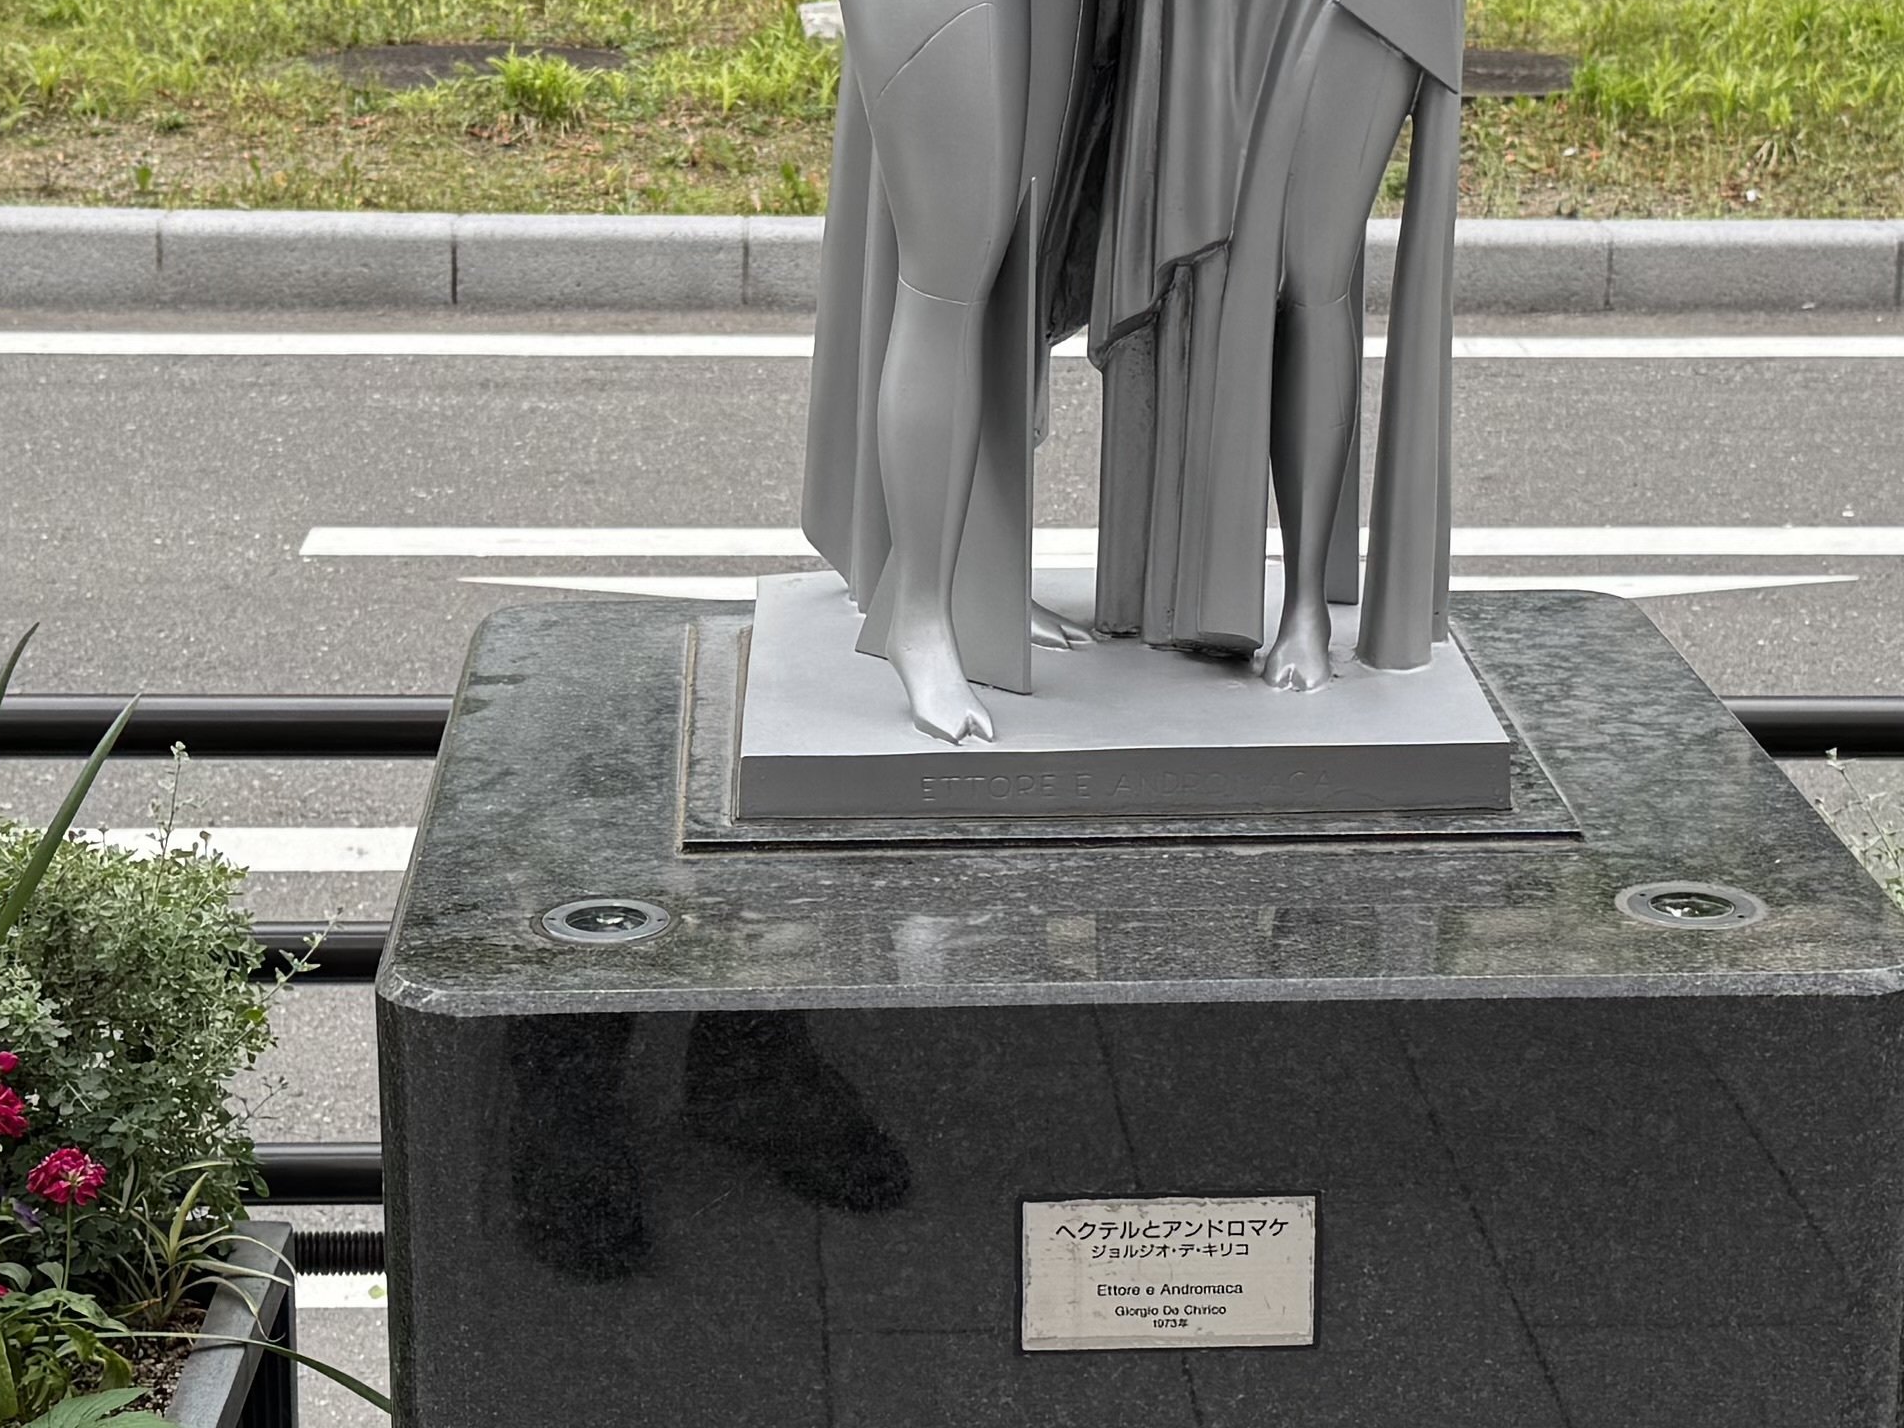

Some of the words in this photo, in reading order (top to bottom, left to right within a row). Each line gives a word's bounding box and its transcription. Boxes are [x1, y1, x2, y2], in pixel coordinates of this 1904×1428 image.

[1076, 773, 1093, 800] E
[1109, 770, 1329, 798] ANDROACA
[1055, 1218, 1289, 1240] ヘクテルとアンドロマケ
[1097, 1284, 1140, 1296] Ettore
[1146, 1286, 1155, 1296] e
[1160, 1283, 1243, 1295] Andromaca
[1114, 1306, 1159, 1318] Giorgio
[1163, 1305, 1179, 1316] De
[1184, 1304, 1227, 1316] Chirico
